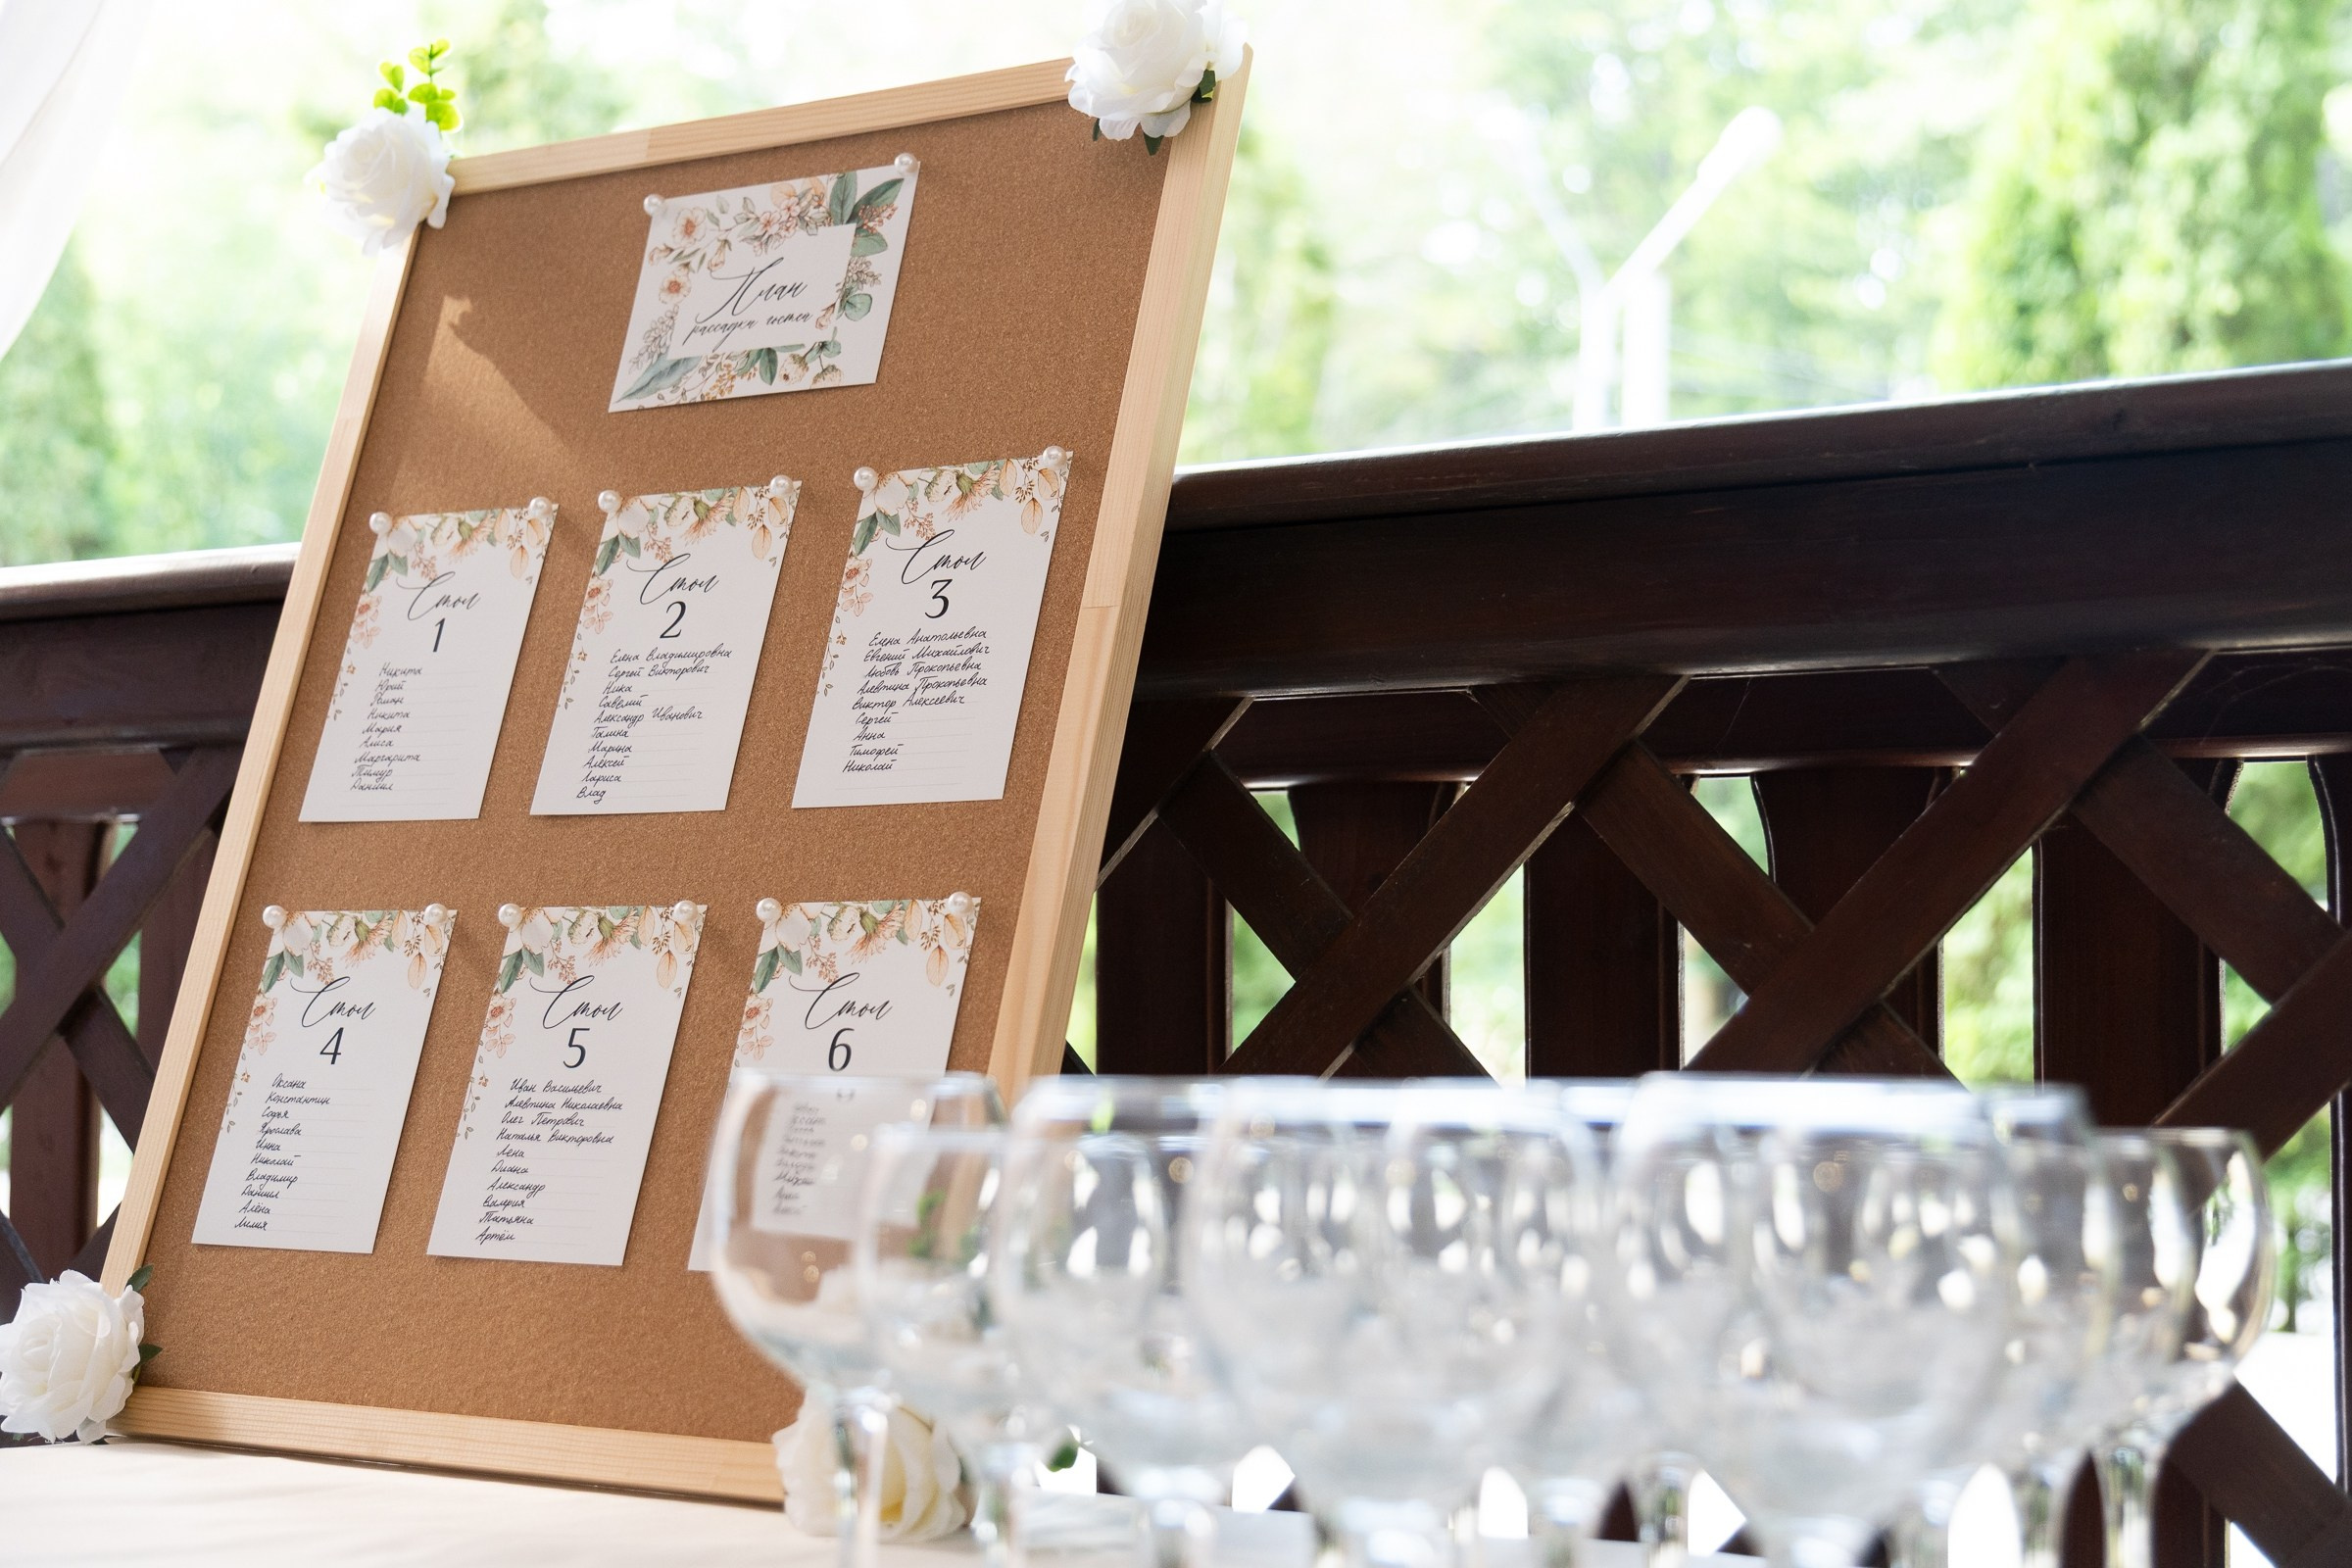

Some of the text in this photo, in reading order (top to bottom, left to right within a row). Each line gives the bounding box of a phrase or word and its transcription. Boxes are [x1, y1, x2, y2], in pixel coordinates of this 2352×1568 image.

[695, 257, 808, 323] План
[682, 318, 758, 353] рассадки
[886, 529, 987, 584] Стол
[626, 553, 719, 605] Стол
[396, 571, 481, 620] Стол
[925, 579, 954, 618] 3
[660, 601, 687, 639] 2
[433, 617, 446, 653] 1
[869, 625, 987, 647] Елена Анатольевна
[610, 643, 732, 667] Елена Владимировна
[863, 642, 991, 662] Евгений Михайлович
[379, 662, 422, 677] Никита
[608, 660, 710, 681] Сергей Викторович
[864, 656, 982, 678] Любовь Прокопьевна
[375, 679, 407, 695] Юрий
[602, 681, 632, 695] Ника
[857, 671, 987, 696] Алевтина Прокопьевна
[370, 692, 404, 707] Роман
[598, 694, 649, 710] Савелий
[852, 689, 965, 714] Виктор Алексеевич
[368, 708, 410, 719] Никита
[594, 706, 703, 729] Александр Иванович
[856, 711, 899, 729] Сергей
[363, 722, 402, 738] Мария
[592, 726, 629, 739] Галина
[853, 725, 886, 741] Анна
[359, 736, 394, 748] Алиса
[588, 741, 632, 758] Марина
[355, 752, 420, 766] Маргарита
[850, 744, 905, 761] Тимофей
[583, 755, 629, 769] Алексей
[843, 759, 898, 773] Николай
[352, 764, 393, 783] Тимур
[582, 770, 621, 787] Лариса
[350, 777, 393, 791] Даниил
[576, 786, 607, 805] Влад
[290, 976, 376, 1028] Стол
[529, 974, 624, 1030] Стол
[789, 972, 893, 1030] Стол
[319, 1027, 344, 1065] 4
[563, 1027, 591, 1069] 5
[828, 1027, 856, 1072] 6
[271, 1072, 307, 1090] Оксана
[510, 1078, 537, 1094] Иван
[265, 1091, 330, 1105] Константин
[505, 1094, 623, 1111] Алевтина Николаевна
[501, 1110, 585, 1131] Олег Петрович
[259, 1122, 302, 1139] Ярослава
[496, 1127, 614, 1147] Наталья Викторовна
[255, 1137, 281, 1152] Инна
[496, 1143, 525, 1157] Лена
[251, 1152, 302, 1166] Николай
[490, 1158, 529, 1174] Диана
[245, 1167, 298, 1191] Владимир
[486, 1176, 546, 1200] Александр
[241, 1184, 280, 1199] Даниил
[238, 1199, 271, 1214] Алёна
[482, 1194, 525, 1211] Валерия
[234, 1216, 269, 1231] Лилия
[478, 1210, 535, 1225] Татьяна
[474, 1225, 516, 1246] Артём
